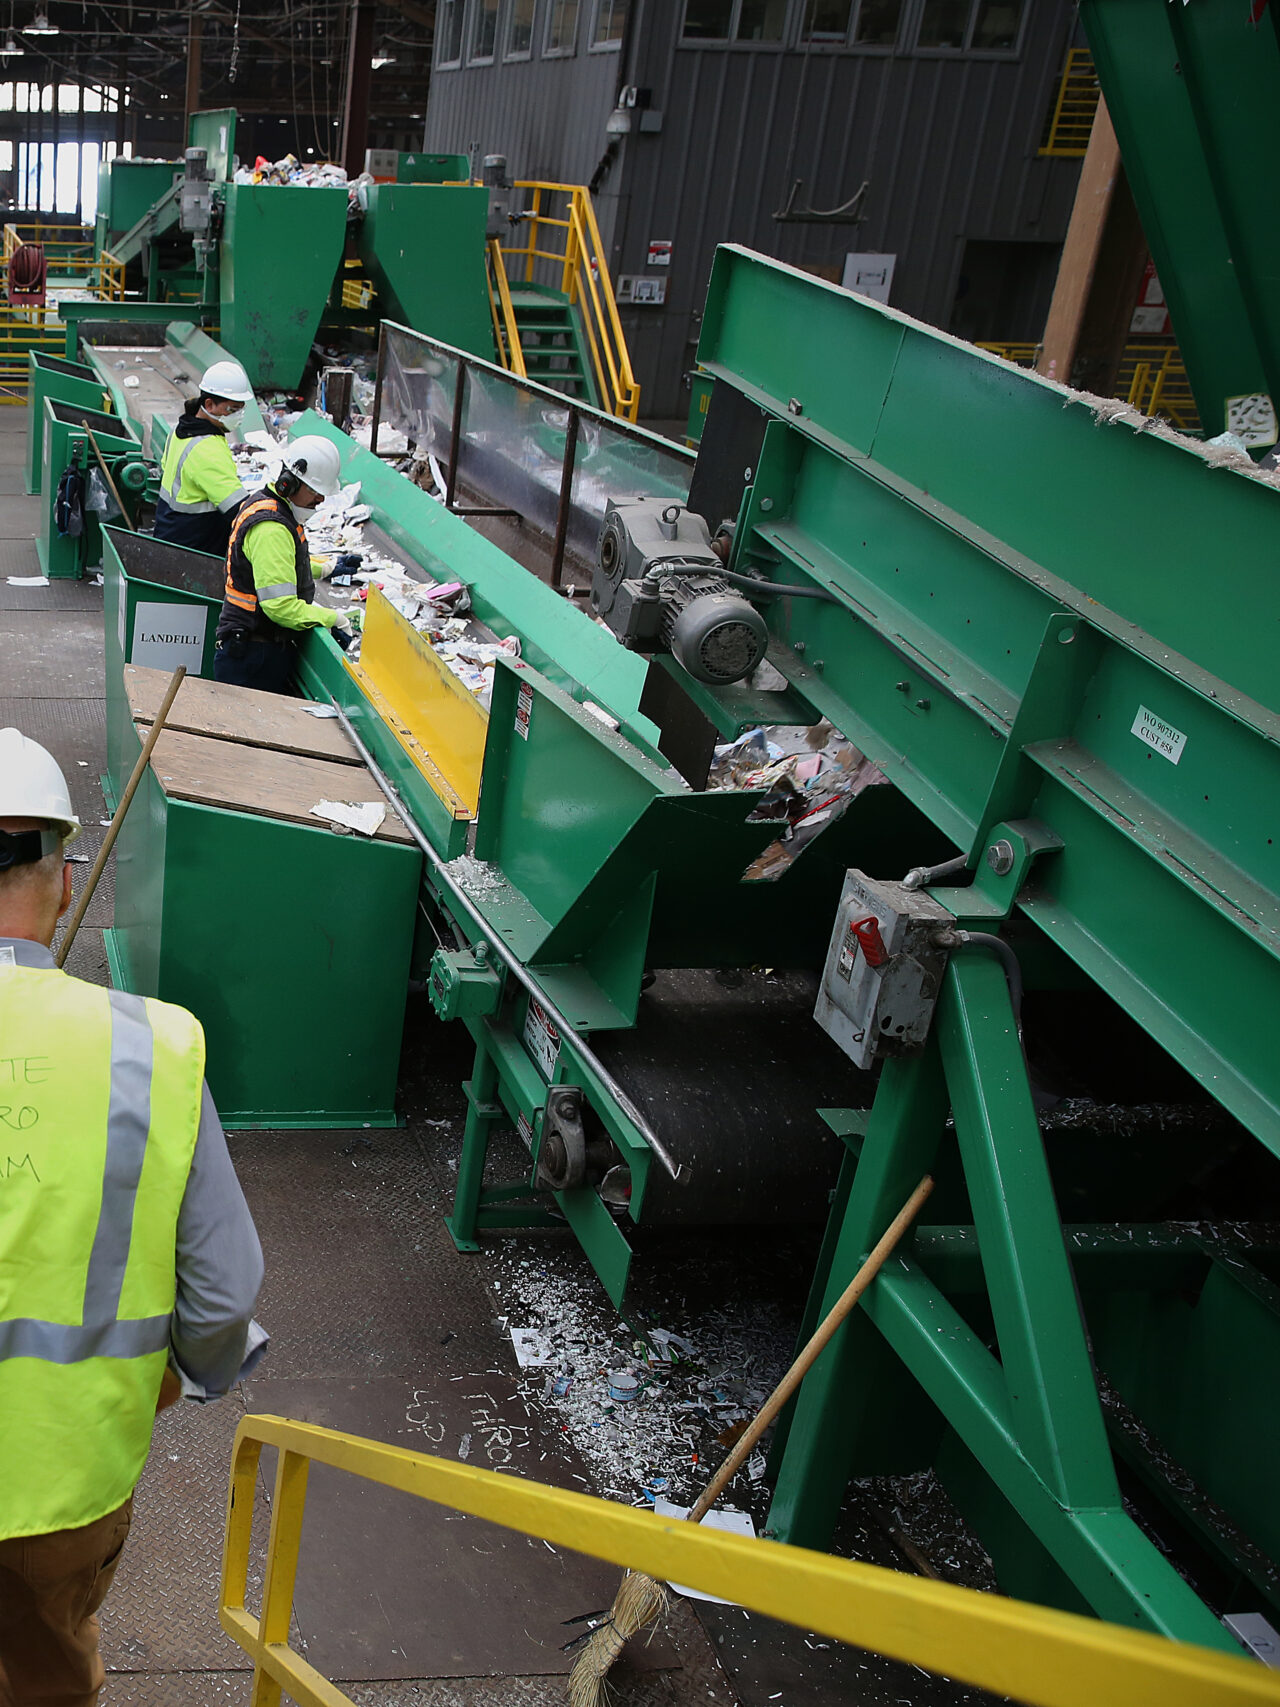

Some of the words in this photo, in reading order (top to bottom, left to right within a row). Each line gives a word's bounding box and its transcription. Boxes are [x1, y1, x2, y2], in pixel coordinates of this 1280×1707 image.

[141, 633, 200, 645] LANDFILL
[1140, 726, 1161, 745] CUST
[1160, 741, 1174, 754] #58
[1143, 711, 1157, 727] WO
[1157, 722, 1180, 744] 907312
